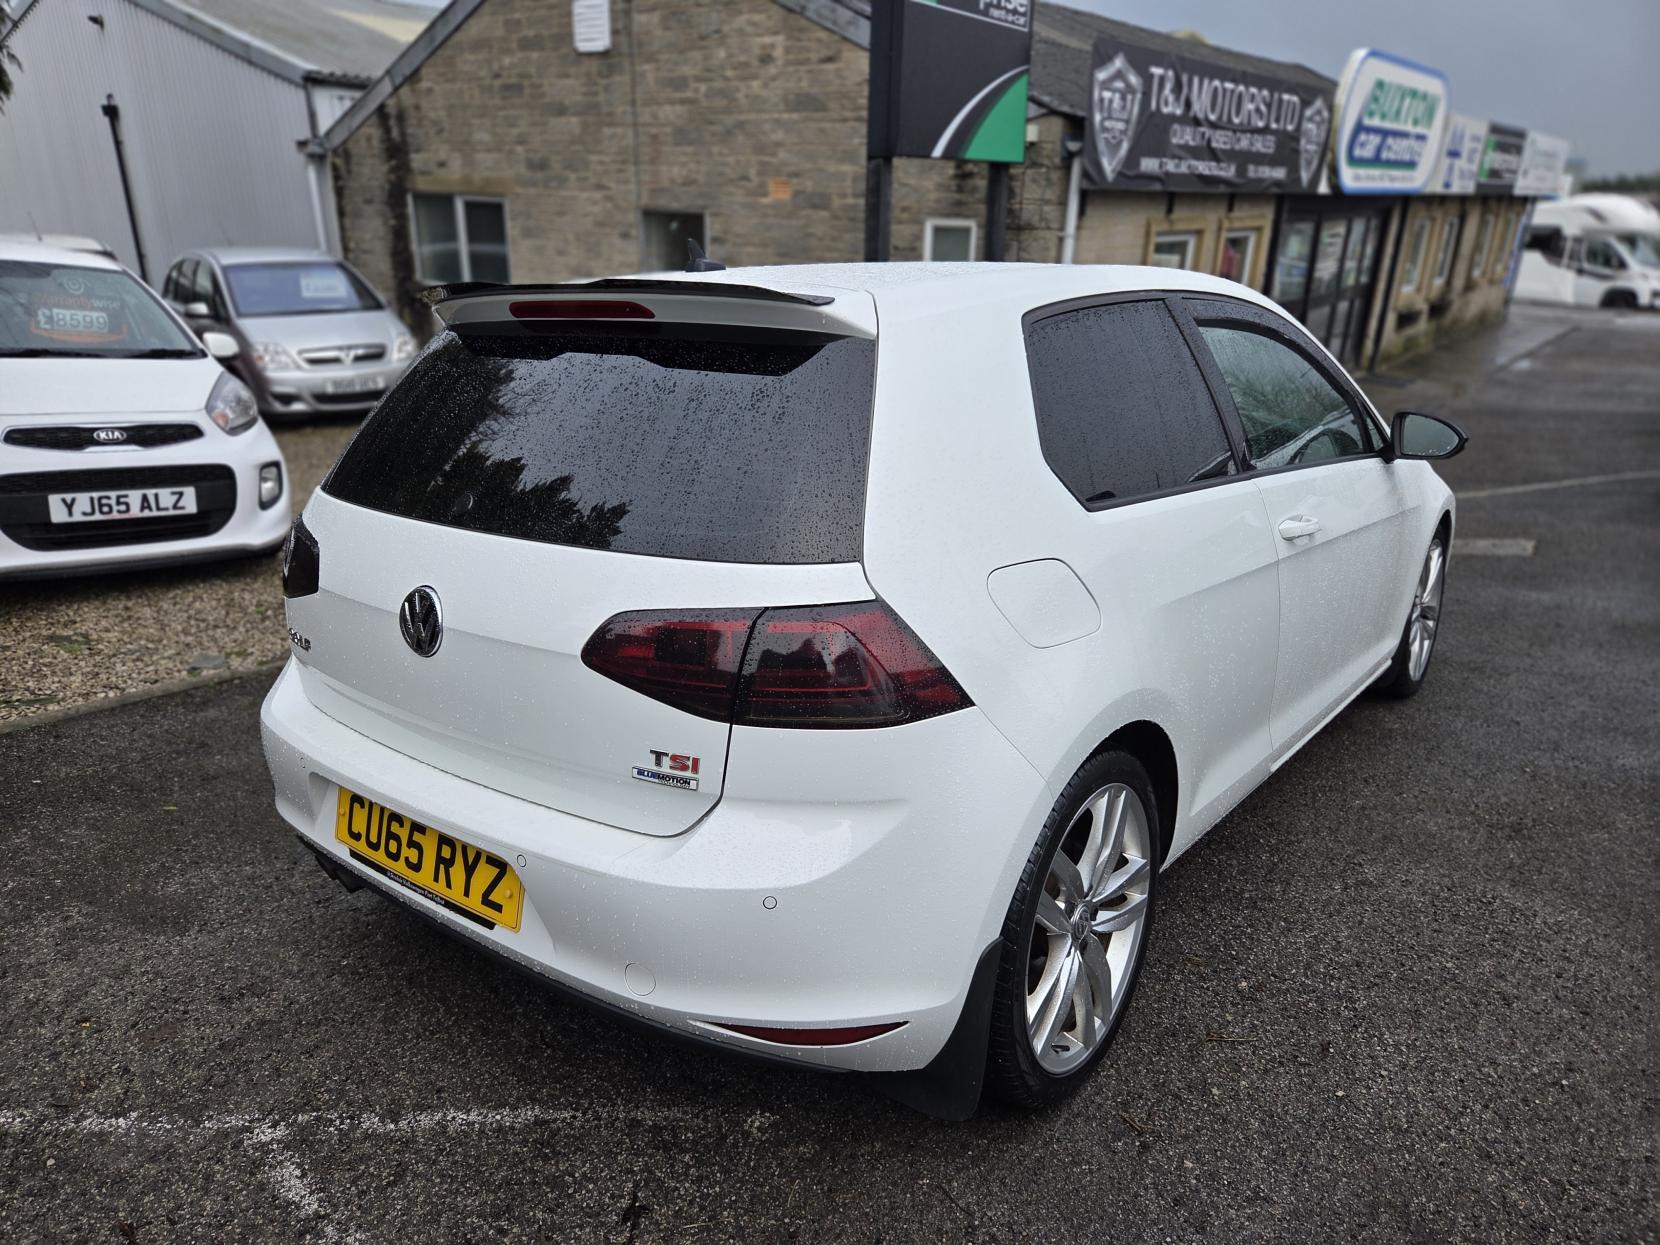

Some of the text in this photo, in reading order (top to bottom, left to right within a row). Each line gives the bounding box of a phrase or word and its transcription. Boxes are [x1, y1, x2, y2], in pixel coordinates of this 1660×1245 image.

[1149, 66, 1301, 131] T&J MOTORS LTD
[1365, 78, 1441, 129] BUXTON
[98, 430, 123, 441] KIA
[60, 490, 186, 518] YJ65 ALZ
[649, 748, 701, 775] TSI
[346, 793, 509, 914] CU65 RYZ
